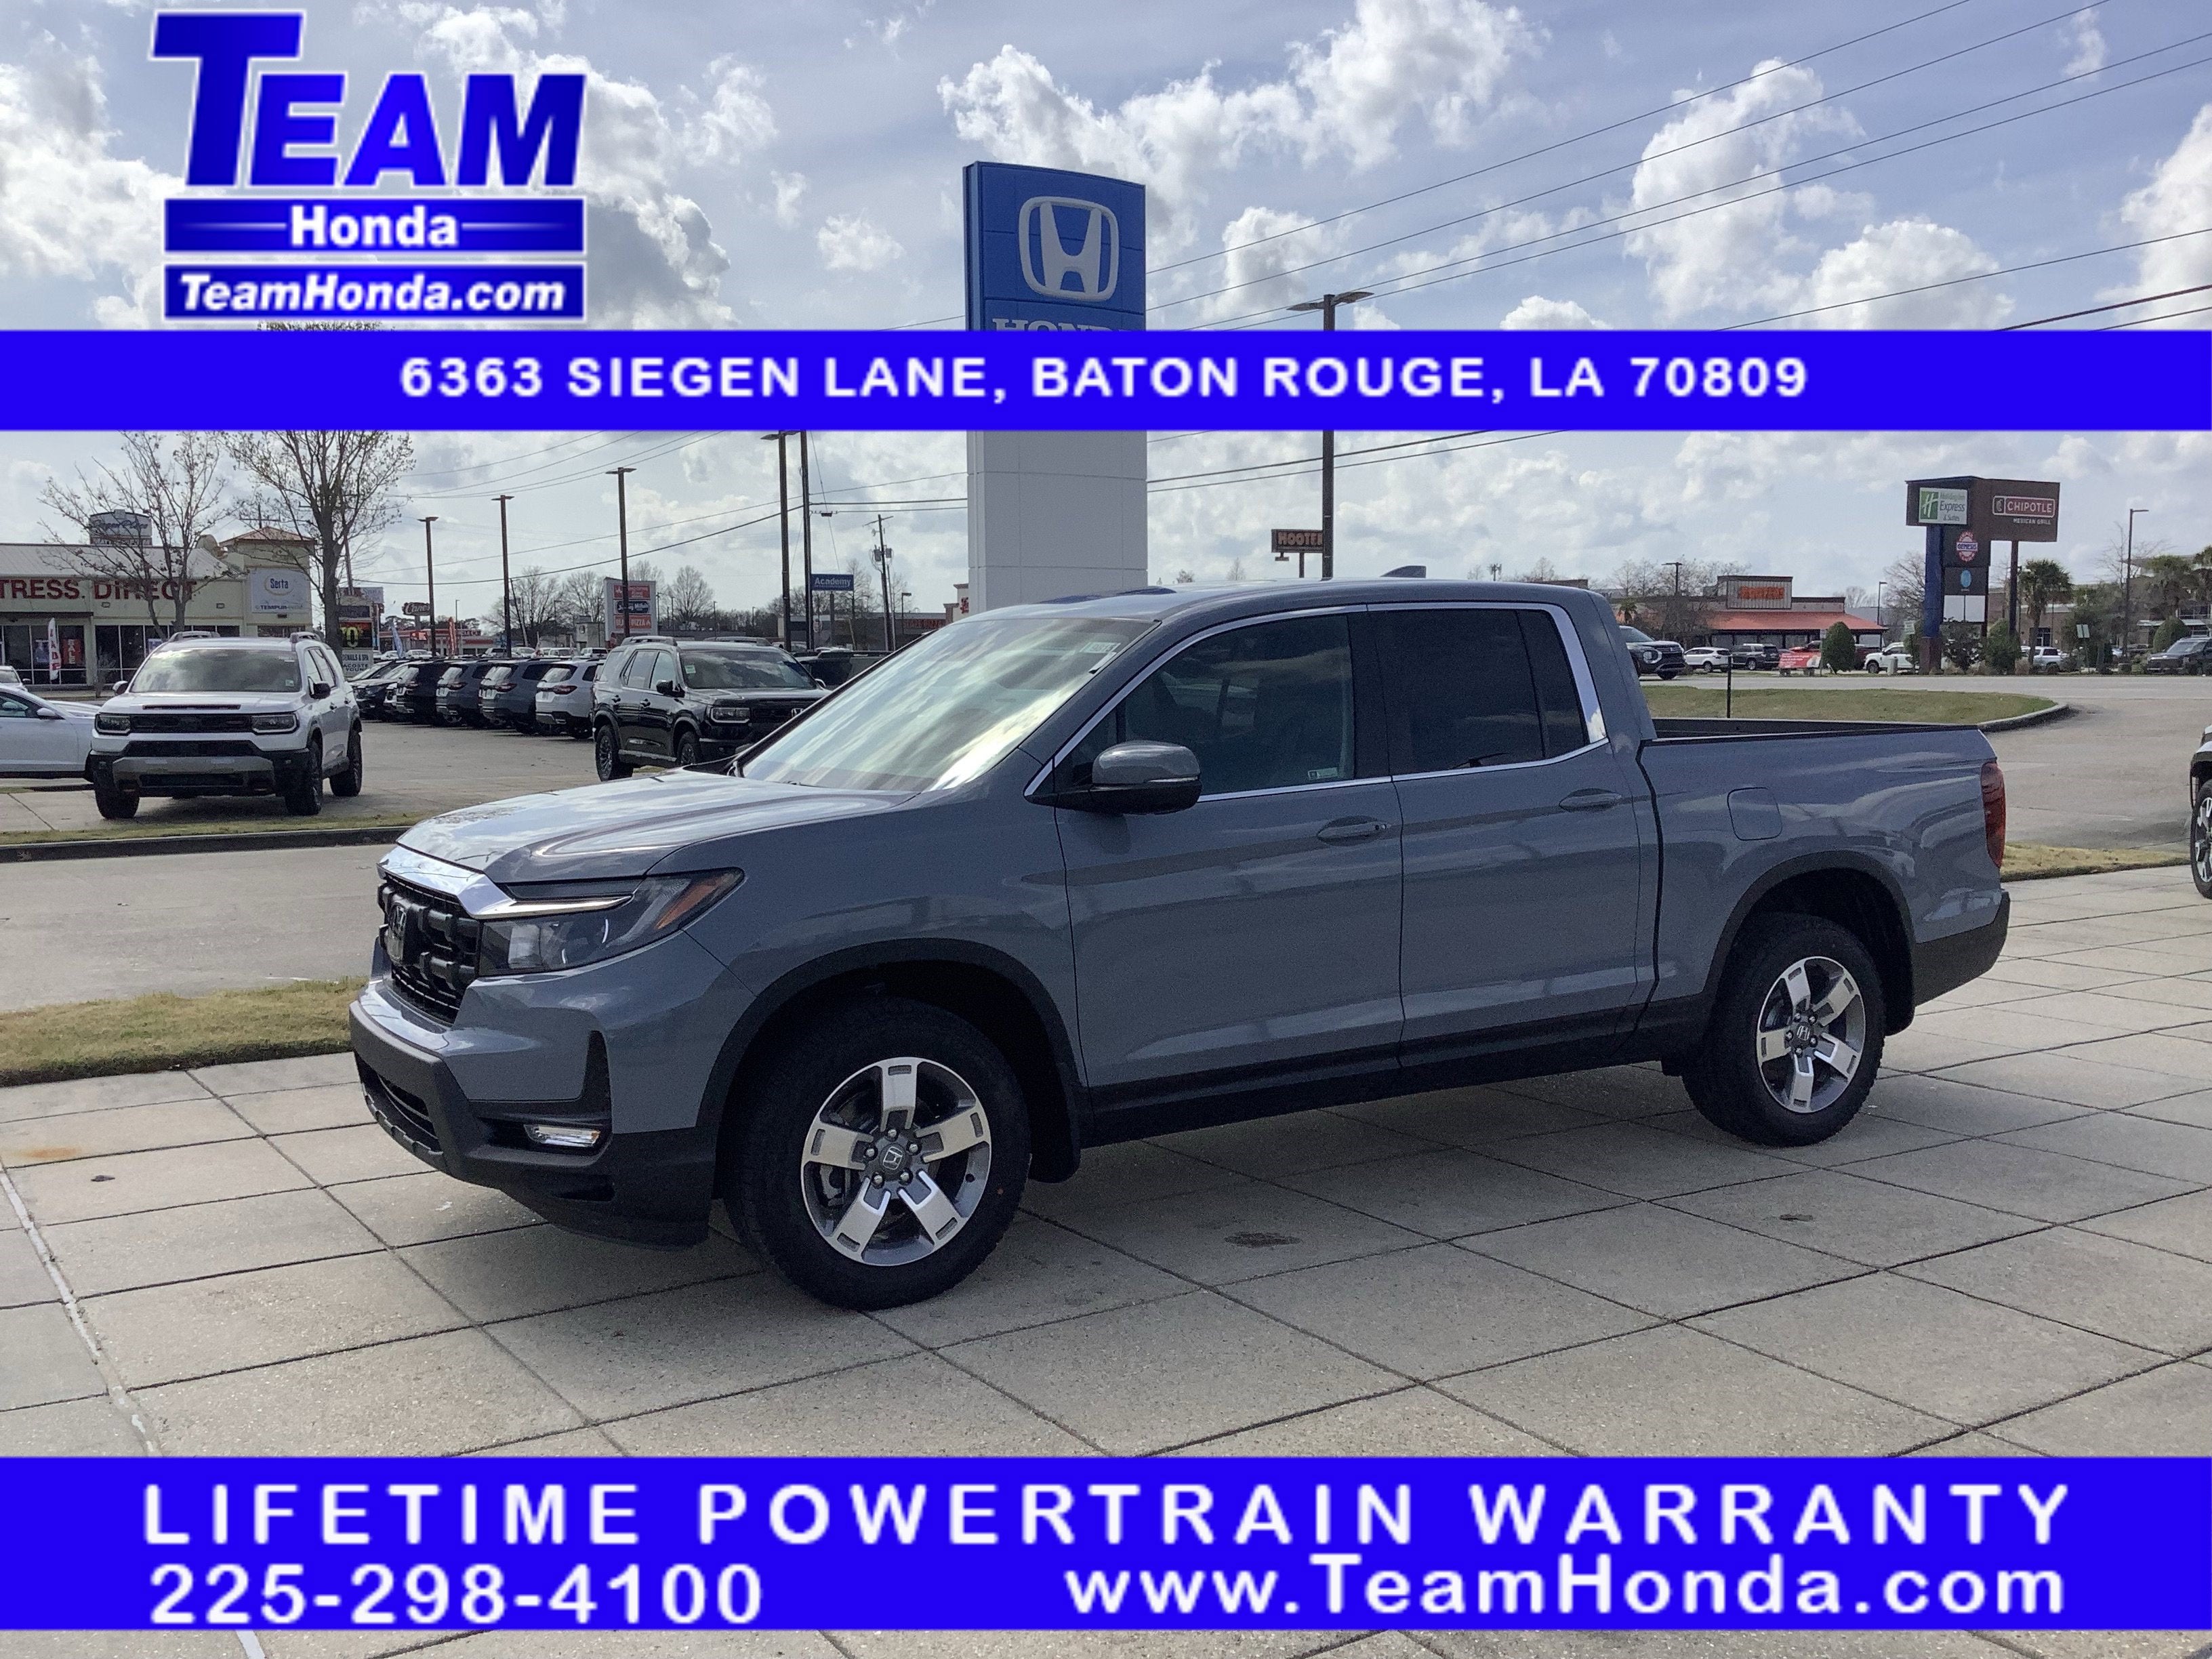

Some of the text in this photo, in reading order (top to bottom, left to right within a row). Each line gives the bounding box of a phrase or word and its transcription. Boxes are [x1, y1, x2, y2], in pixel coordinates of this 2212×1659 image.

[1940, 501, 1965, 513] Express
[2007, 501, 2053, 513] CHIPOTLE
[270, 578, 289, 589] Serta
[815, 577, 851, 587] Academy
